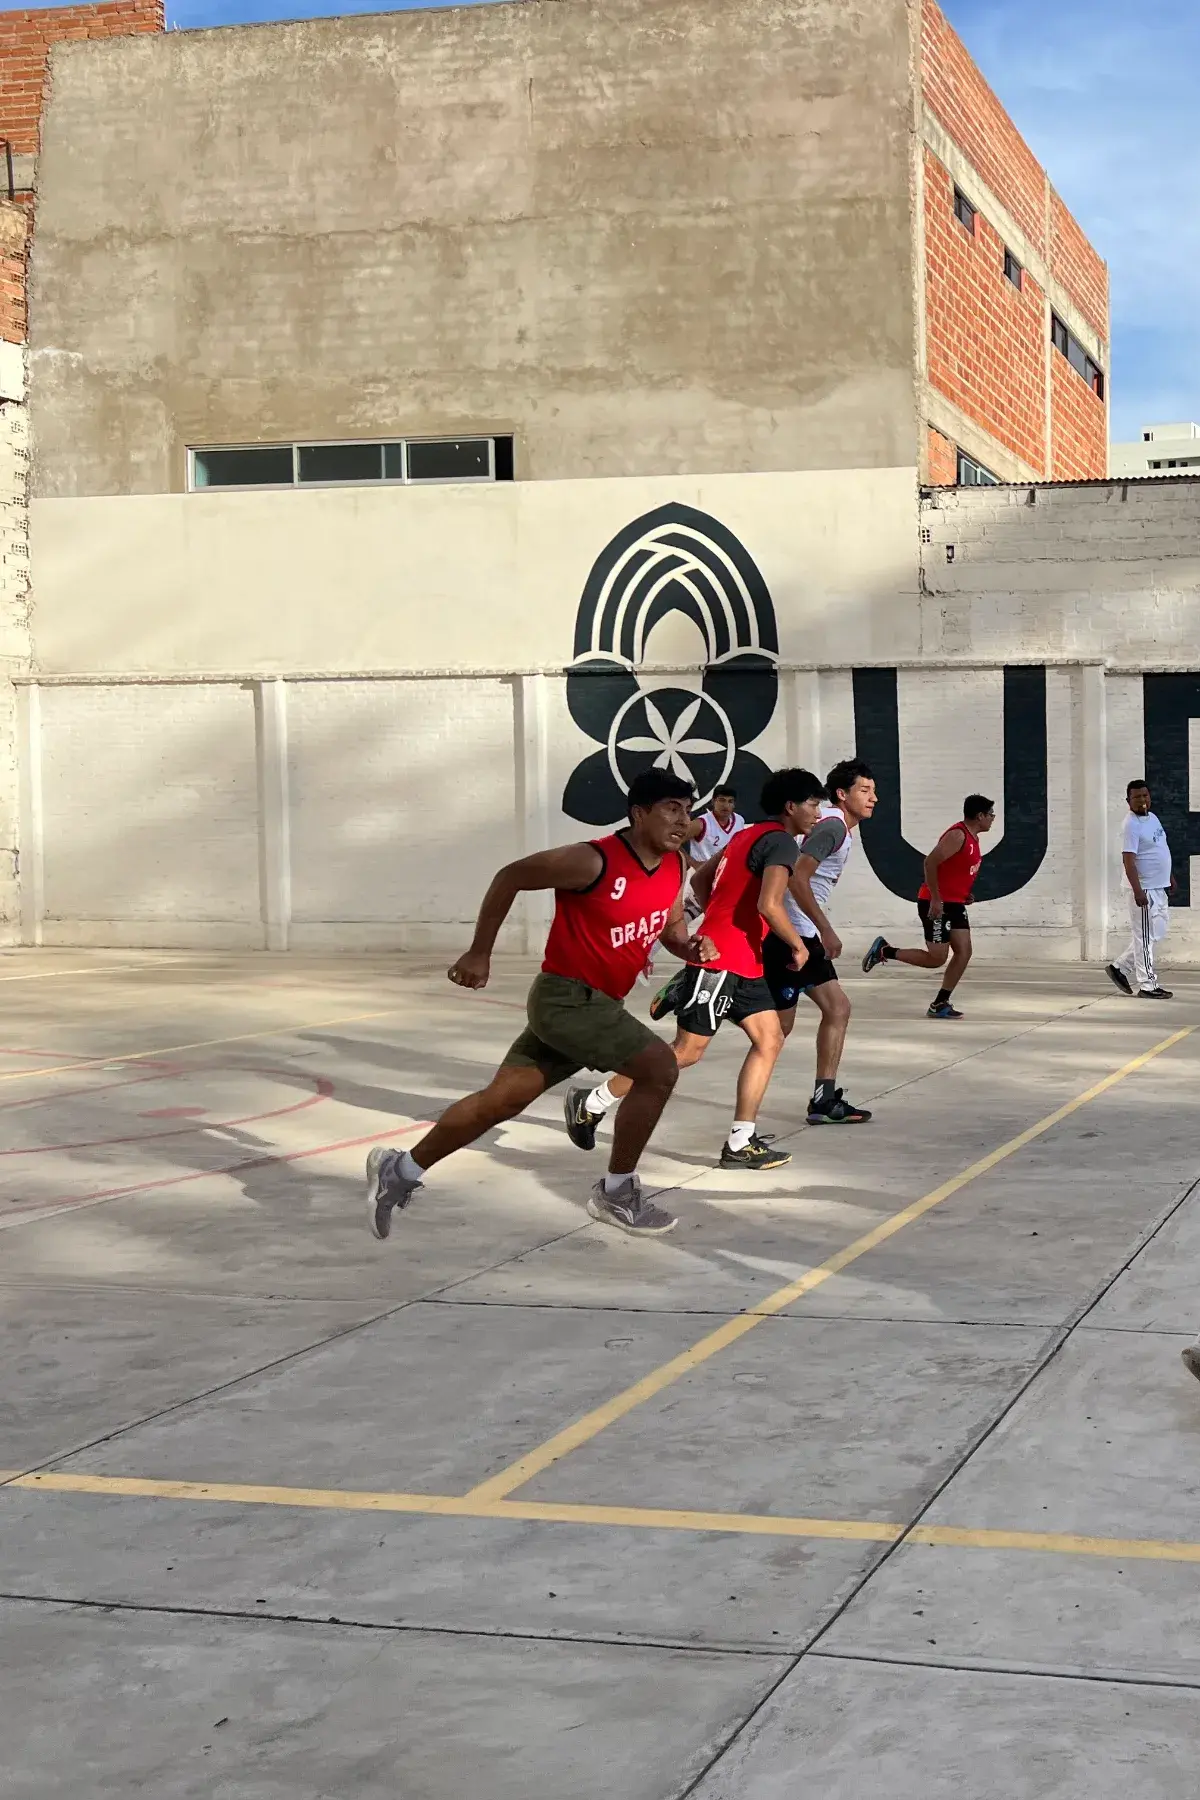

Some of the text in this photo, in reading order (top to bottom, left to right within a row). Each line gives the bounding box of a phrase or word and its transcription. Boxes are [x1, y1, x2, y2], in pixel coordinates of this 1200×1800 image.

[713, 835, 720, 847] 2
[610, 876, 627, 900] 9
[610, 907, 669, 949] DRAFT
